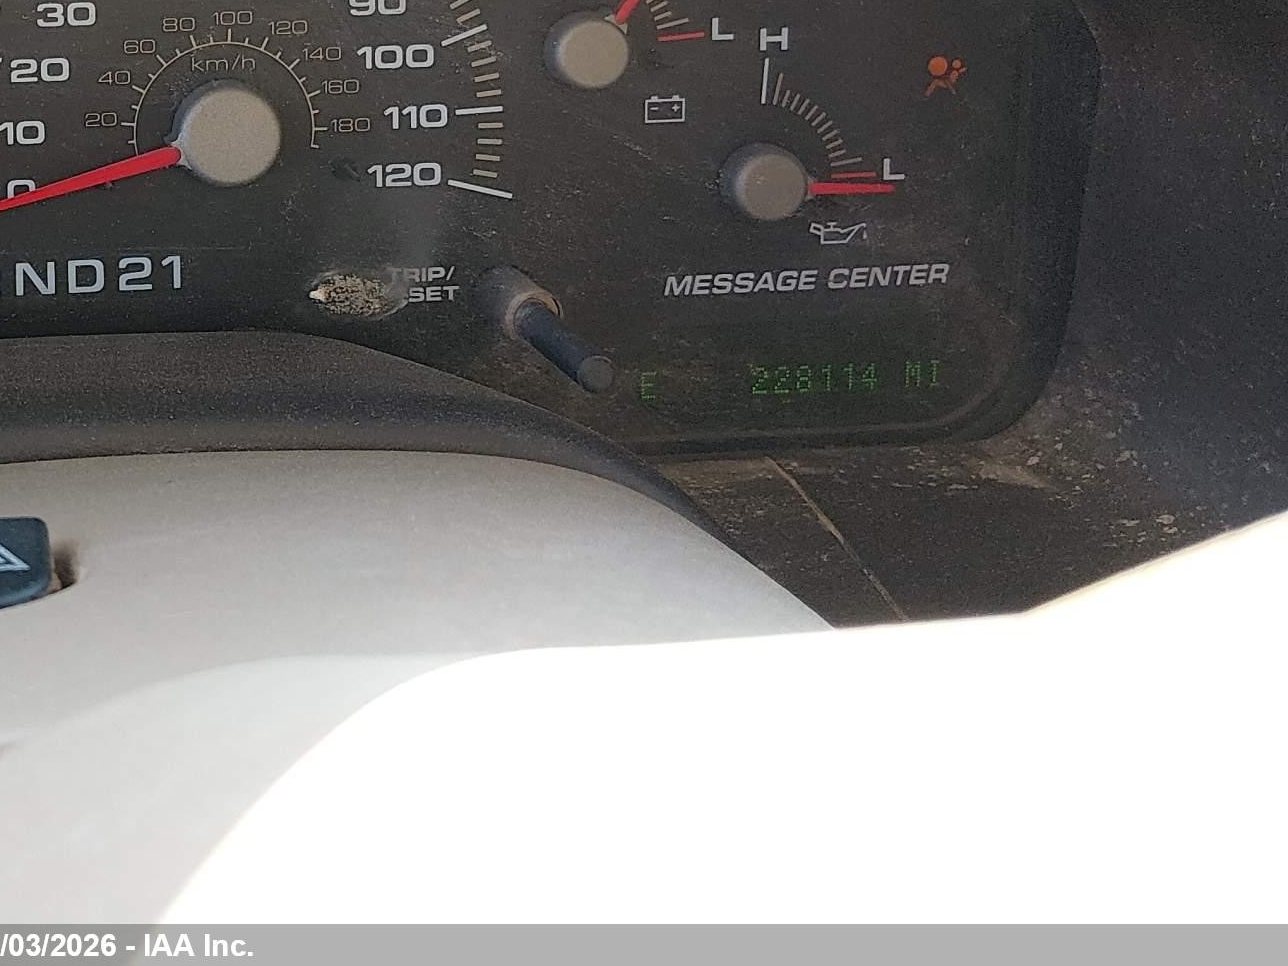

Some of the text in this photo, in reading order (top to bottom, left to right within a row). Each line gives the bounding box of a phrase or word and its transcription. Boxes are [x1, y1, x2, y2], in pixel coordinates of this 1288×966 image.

[36, 1, 96, 27] 30
[212, 11, 253, 25] 100
[162, 17, 195, 32] 80
[268, 20, 308, 35] 120
[712, 17, 734, 40] L
[123, 39, 156, 54] 60
[760, 27, 788, 50] H
[303, 46, 342, 61] 140
[356, 44, 434, 69] 100
[10, 58, 71, 83] 20
[191, 55, 256, 73] km/h
[98, 71, 131, 85] 40
[323, 80, 359, 94] 160
[85, 112, 117, 127] 20
[331, 118, 370, 132] 180
[383, 103, 448, 129] 110
[367, 163, 442, 188] 120
[882, 158, 905, 180] L
[664, 263, 949, 296] MESSAGE CENTER
[409, 285, 460, 303] SET
[640, 360, 940, 400] E 228114 MI
